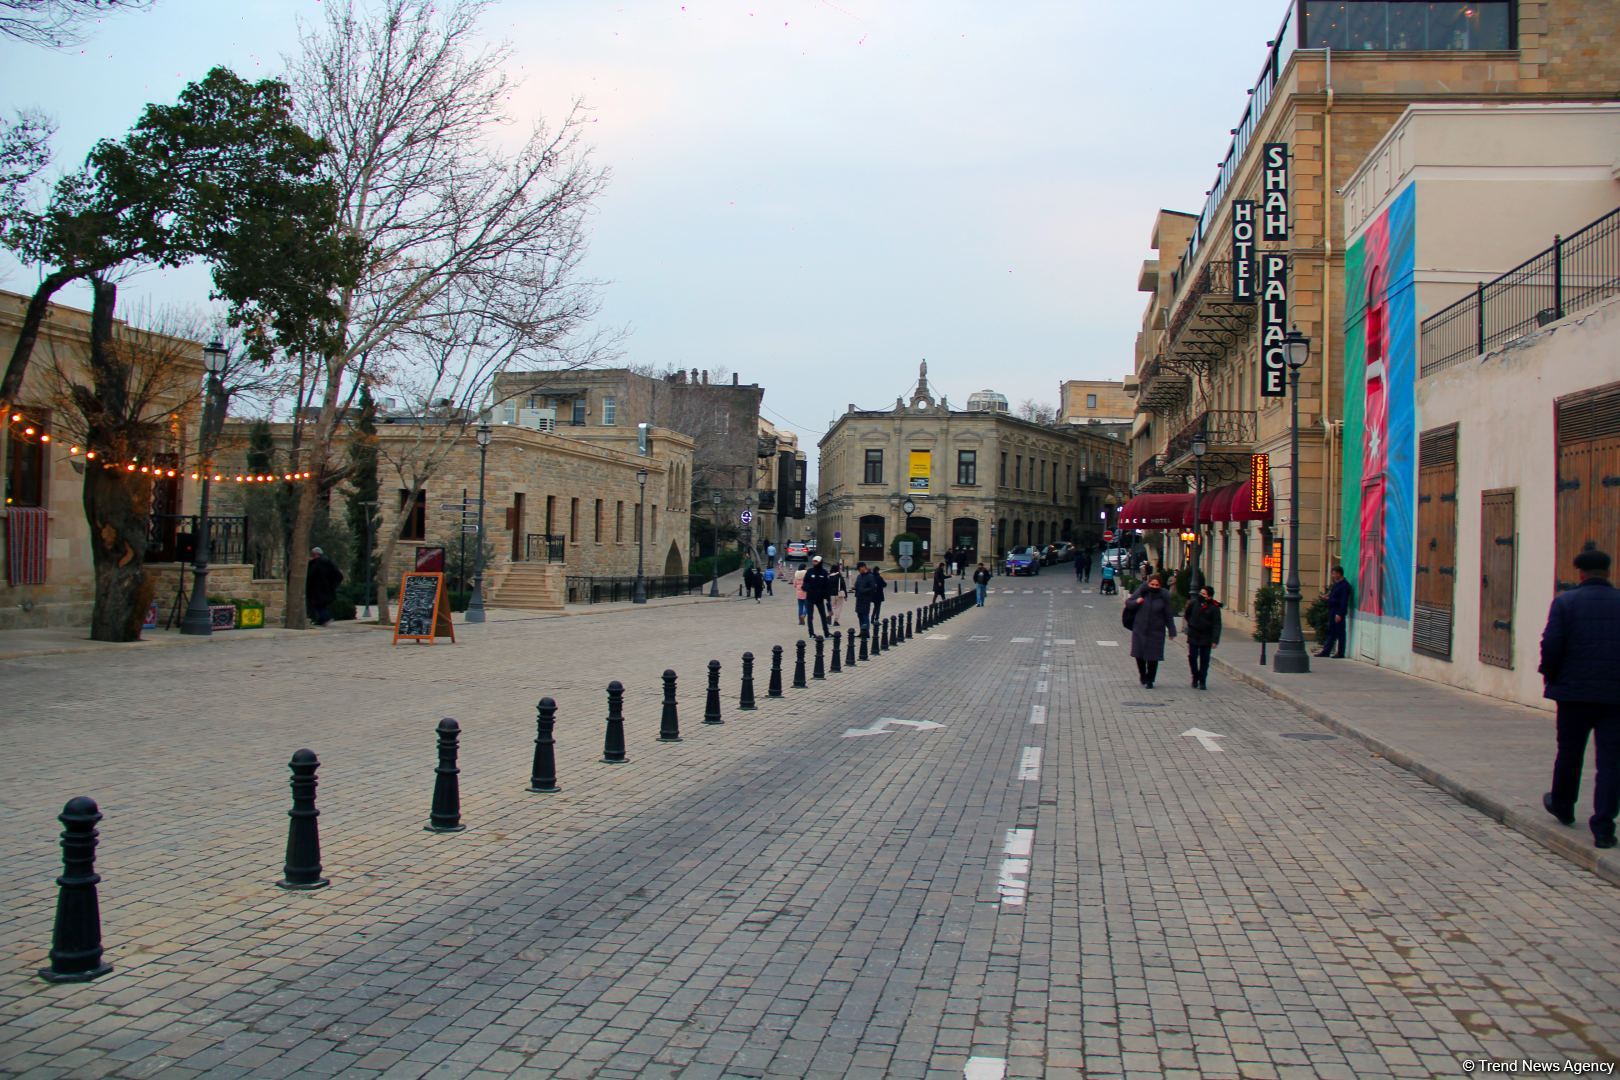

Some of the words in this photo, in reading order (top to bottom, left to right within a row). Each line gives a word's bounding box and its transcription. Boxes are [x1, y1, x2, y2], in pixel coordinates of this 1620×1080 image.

[1266, 147, 1286, 235] SHAH
[1234, 204, 1253, 297] HOTEL
[1265, 257, 1286, 392] PALACE
[1256, 456, 1264, 509] CURRENCY
